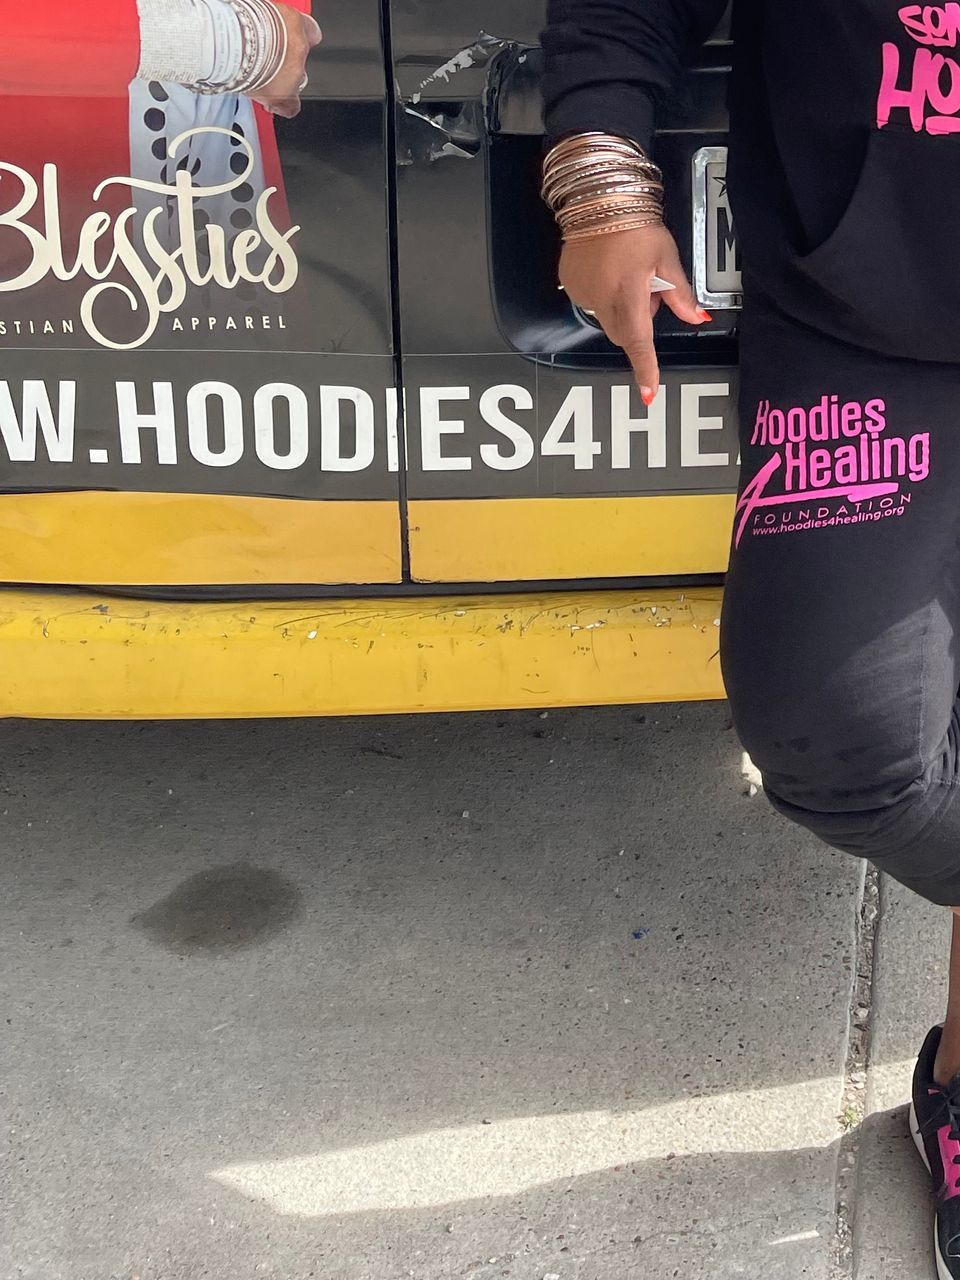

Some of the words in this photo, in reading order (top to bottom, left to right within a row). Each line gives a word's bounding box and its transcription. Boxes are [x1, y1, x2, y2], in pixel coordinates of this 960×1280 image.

[172, 315, 286, 332] APPAREL
[0, 379, 742, 473] W.HOODIES4HE
[751, 395, 886, 446] Hoodies
[785, 431, 930, 491] Healing
[752, 506, 905, 536] www.hoodies4healing.org
[754, 493, 912, 525] FOUNDATION
